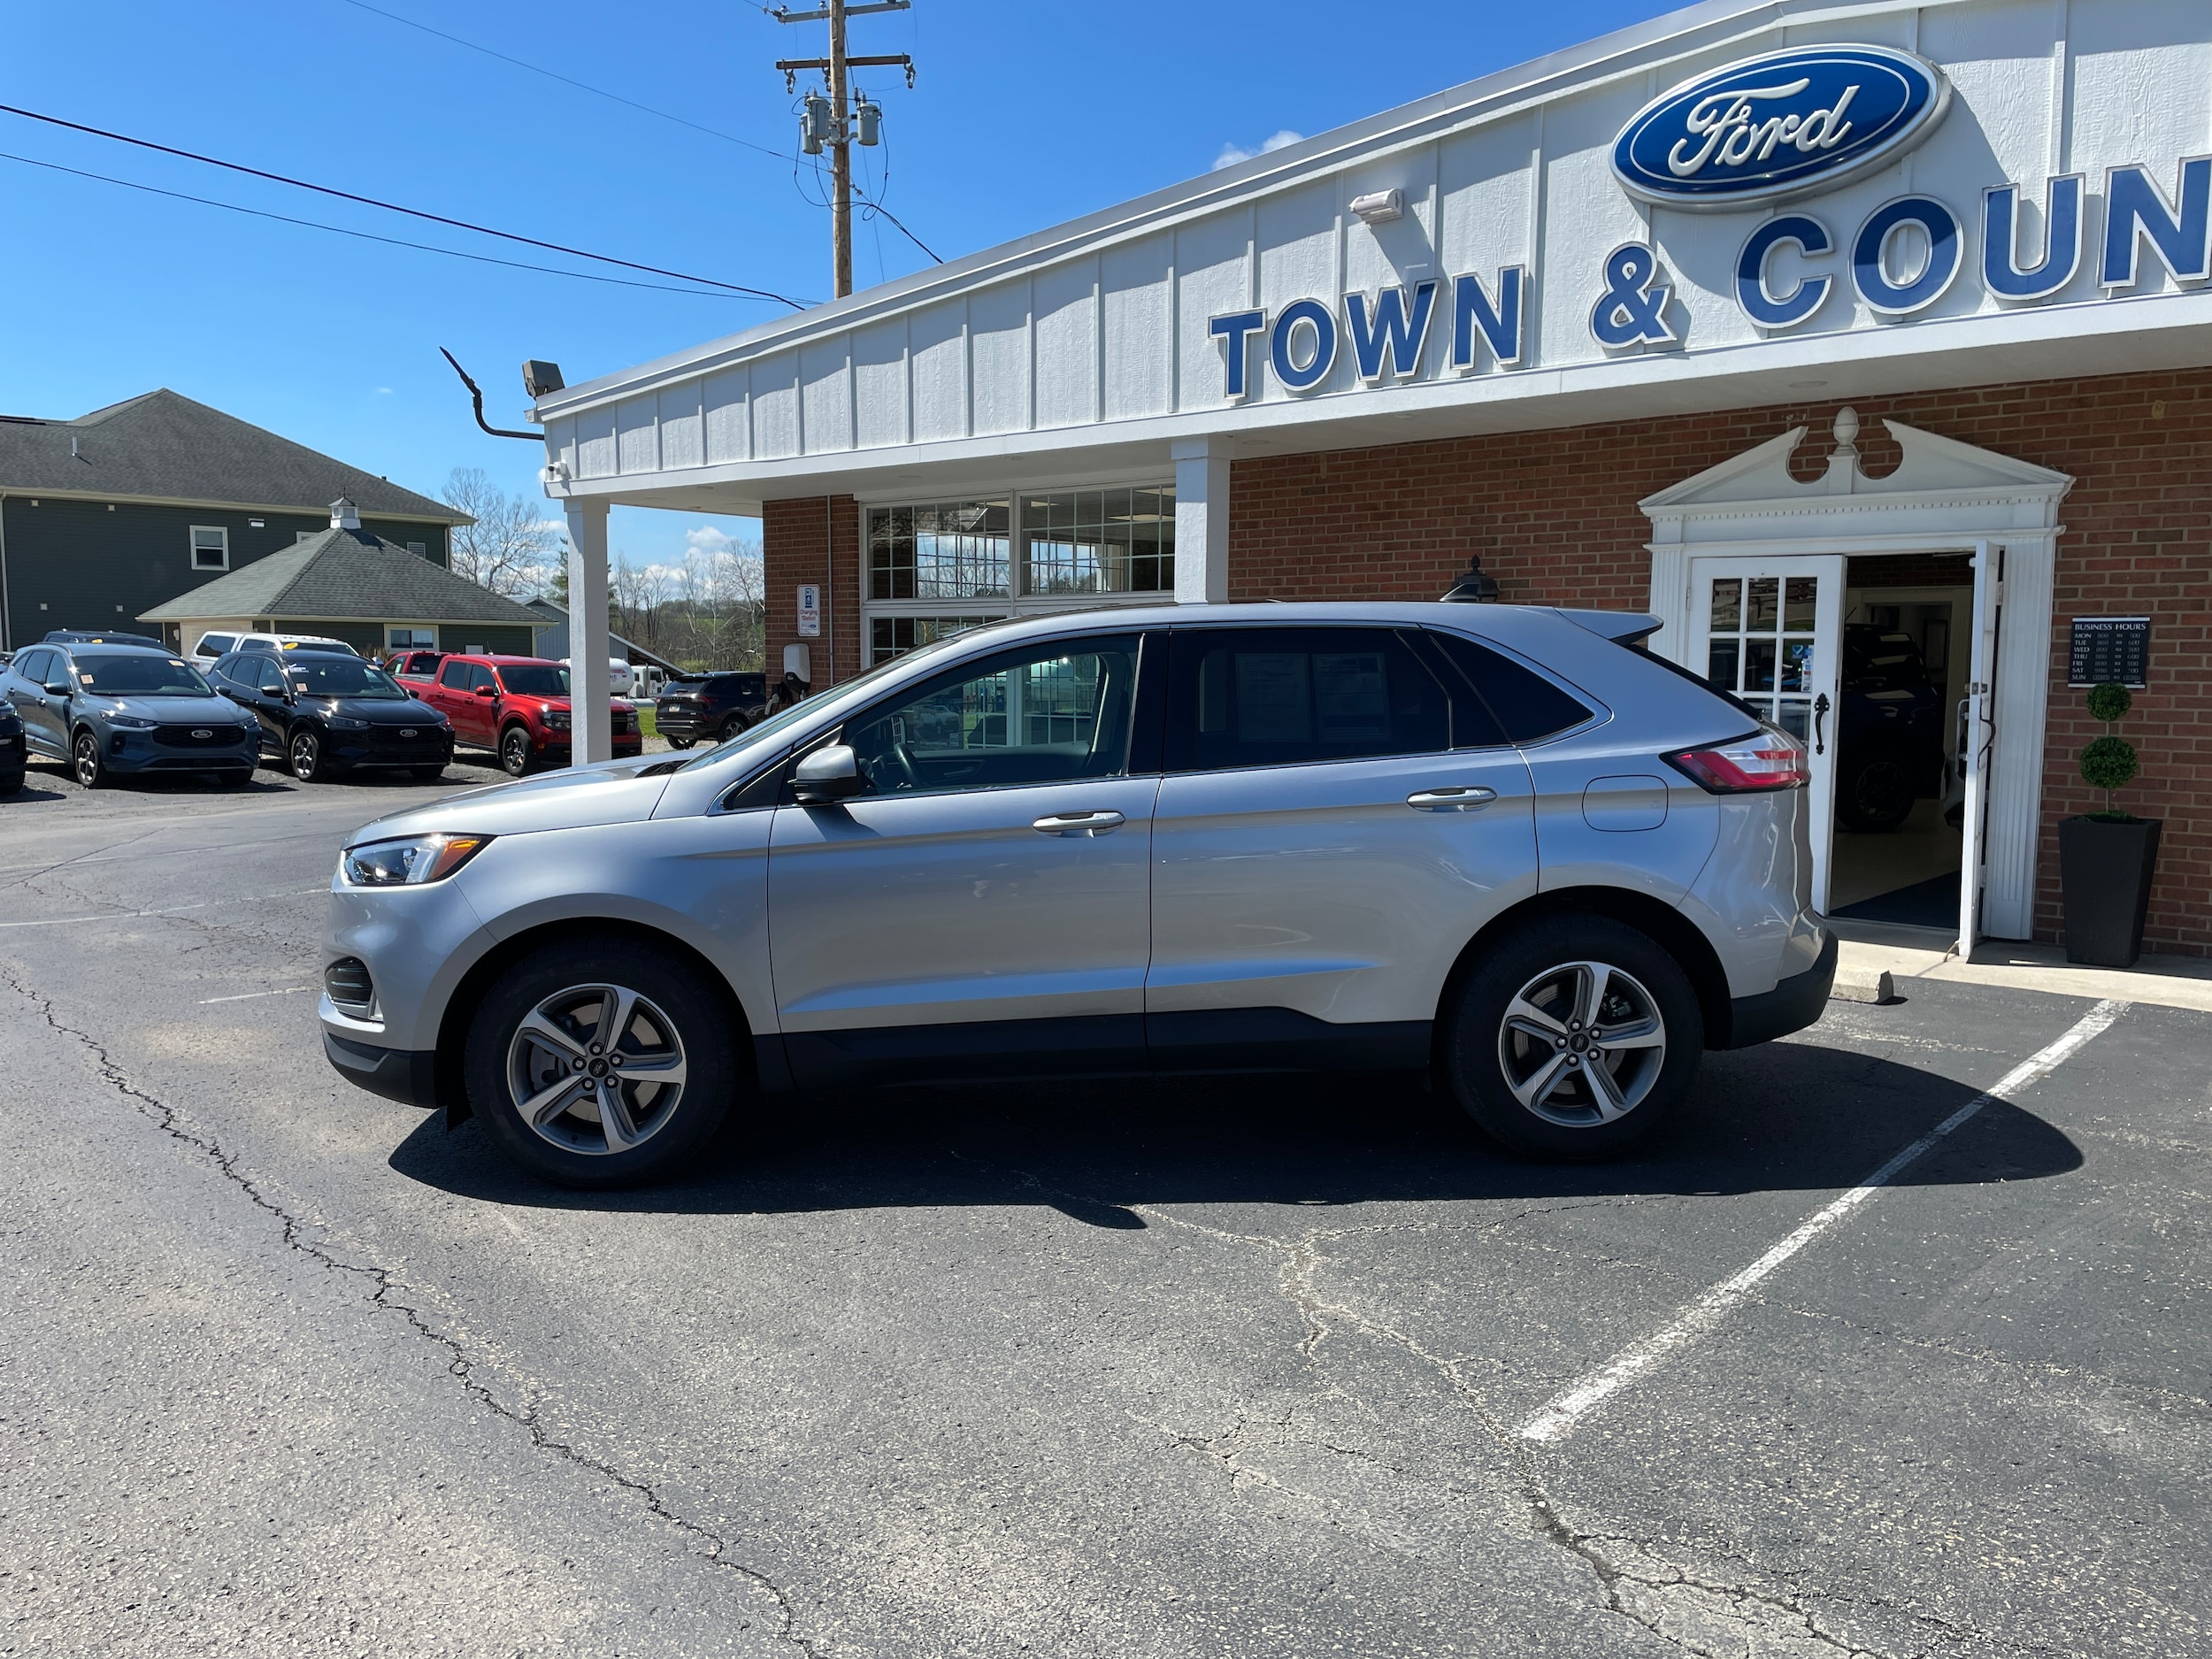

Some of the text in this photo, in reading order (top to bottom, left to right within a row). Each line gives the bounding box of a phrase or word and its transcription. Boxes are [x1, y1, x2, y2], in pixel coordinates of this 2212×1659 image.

[1668, 77, 1860, 177] Ford
[1208, 154, 2212, 399] TOWN & COUN
